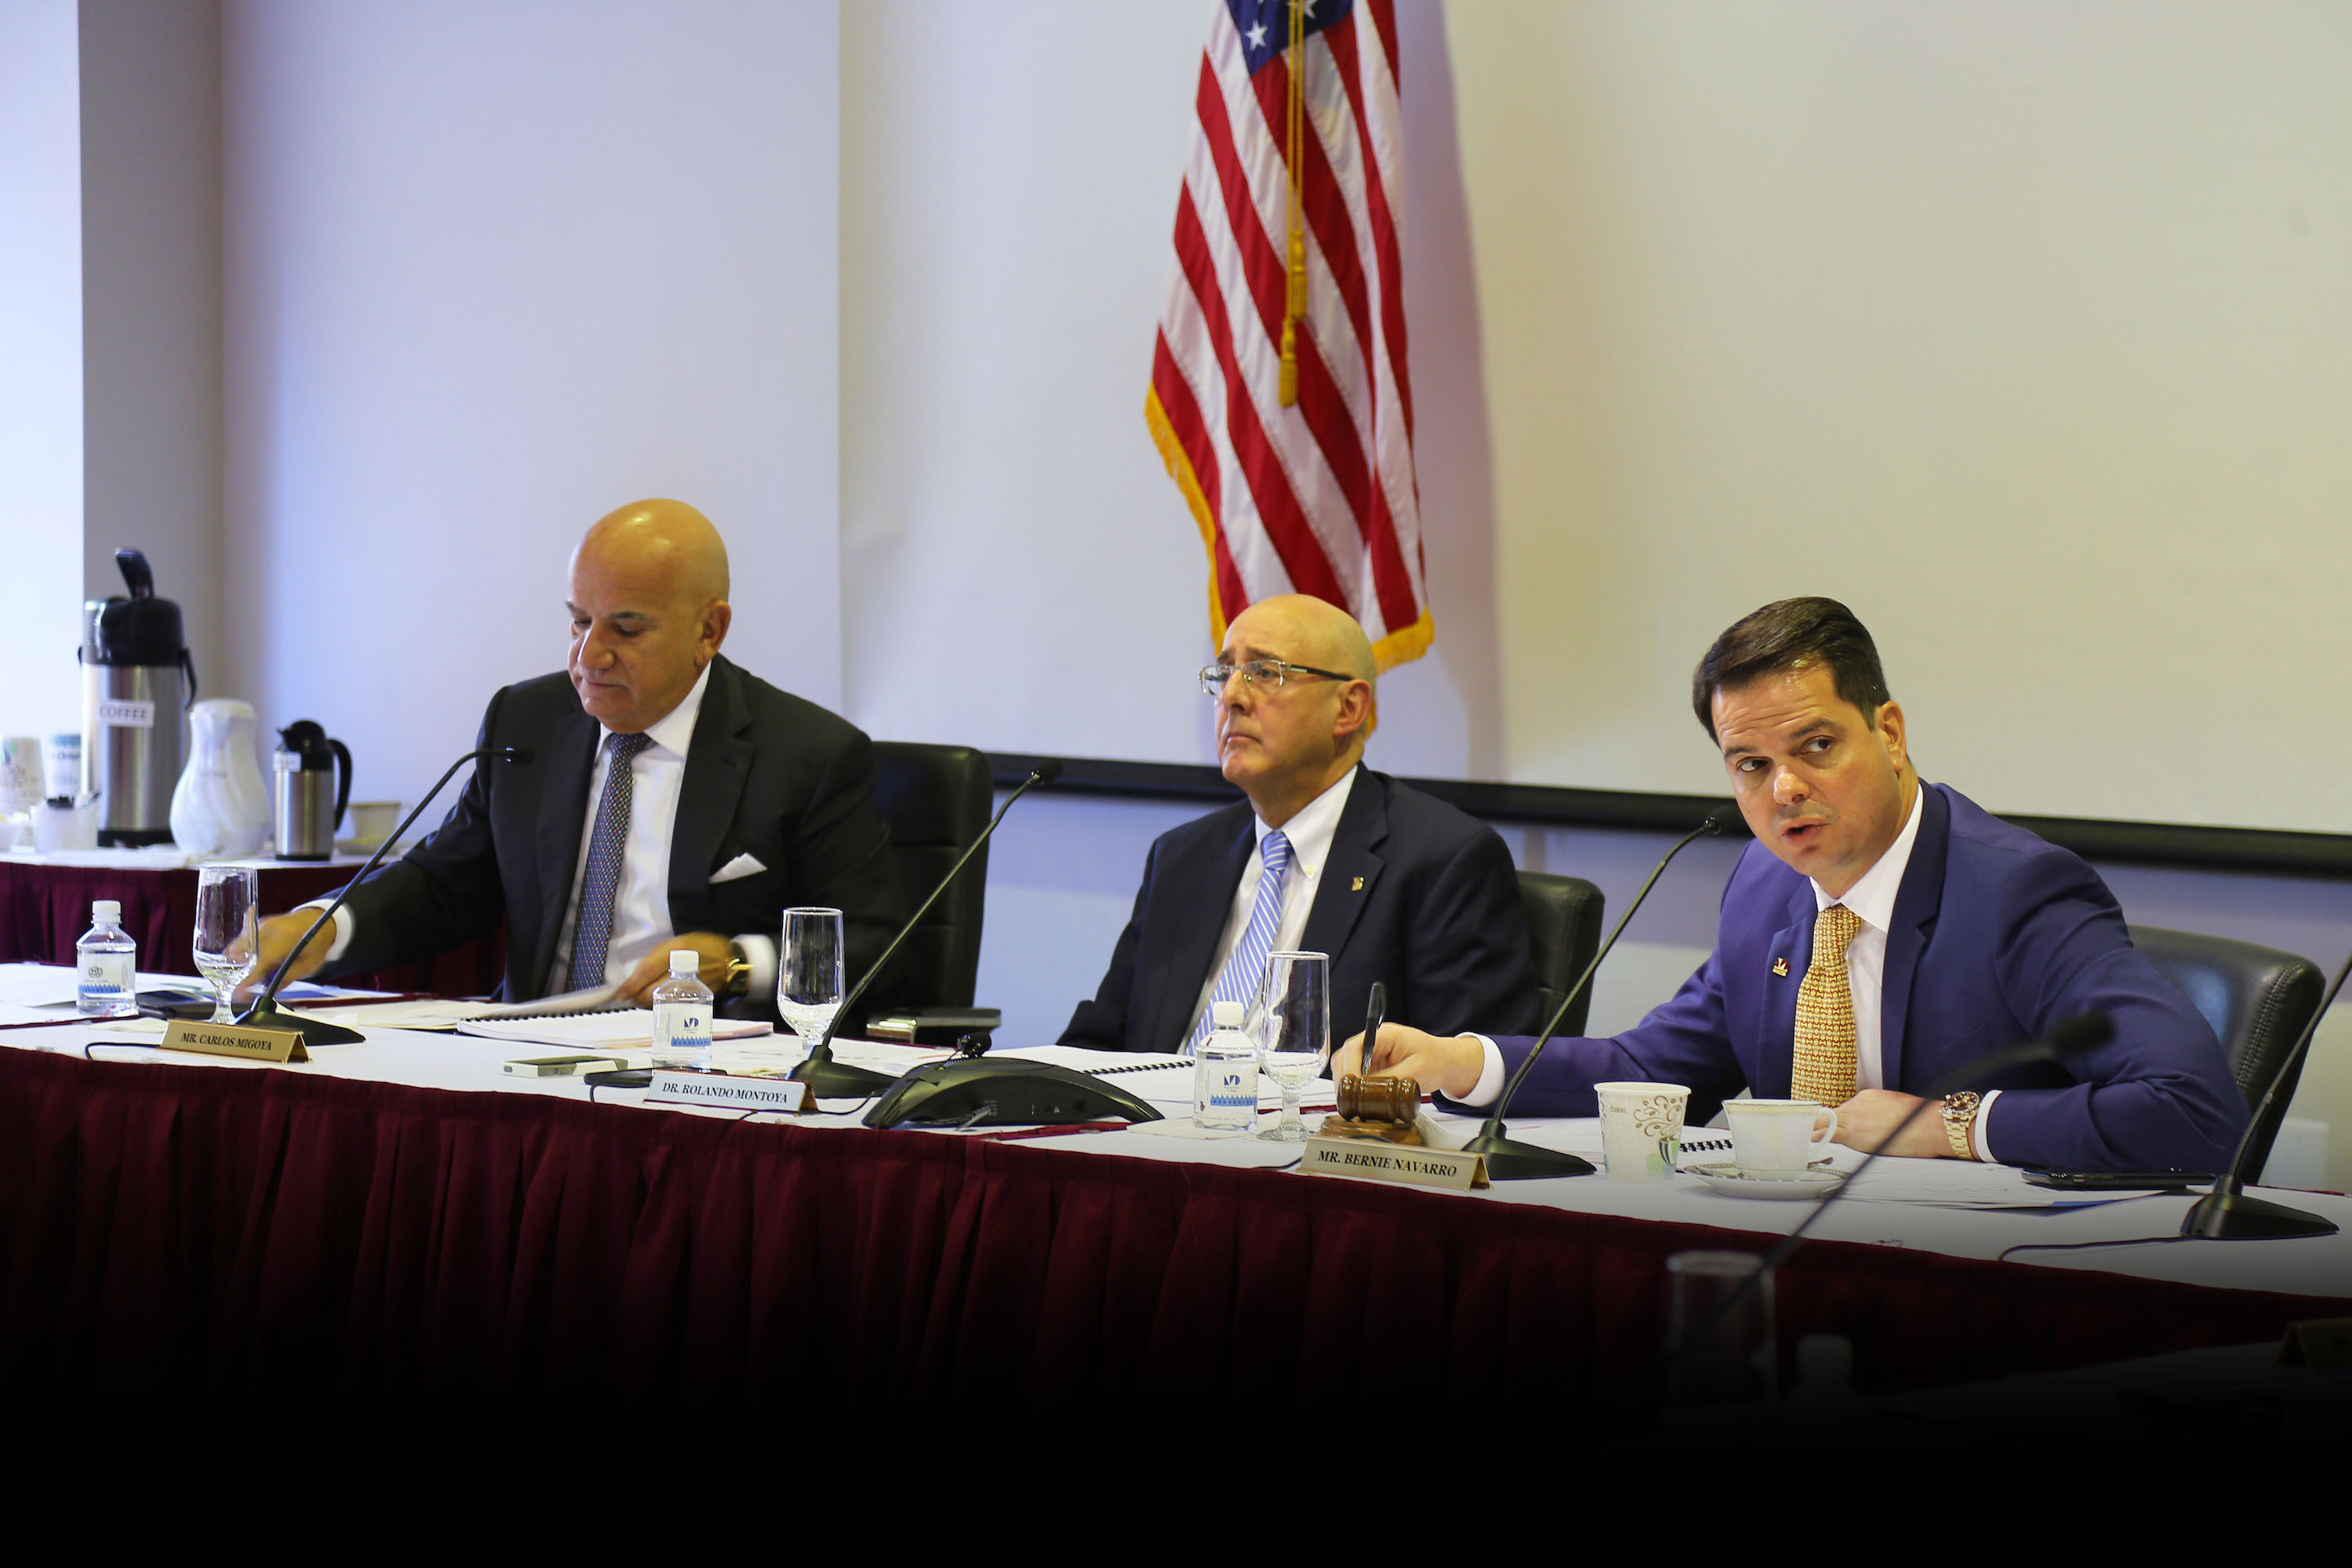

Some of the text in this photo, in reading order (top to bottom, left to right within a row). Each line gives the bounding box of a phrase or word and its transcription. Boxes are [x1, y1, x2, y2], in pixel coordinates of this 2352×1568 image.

[100, 706, 147, 719] COFFEE
[181, 1032, 272, 1051] MR. CARLOS MIGOYA
[662, 1082, 787, 1103] DR. ROLANDO MONTOYA
[1318, 1150, 1457, 1178] MR. BERNIE NAVARRO
